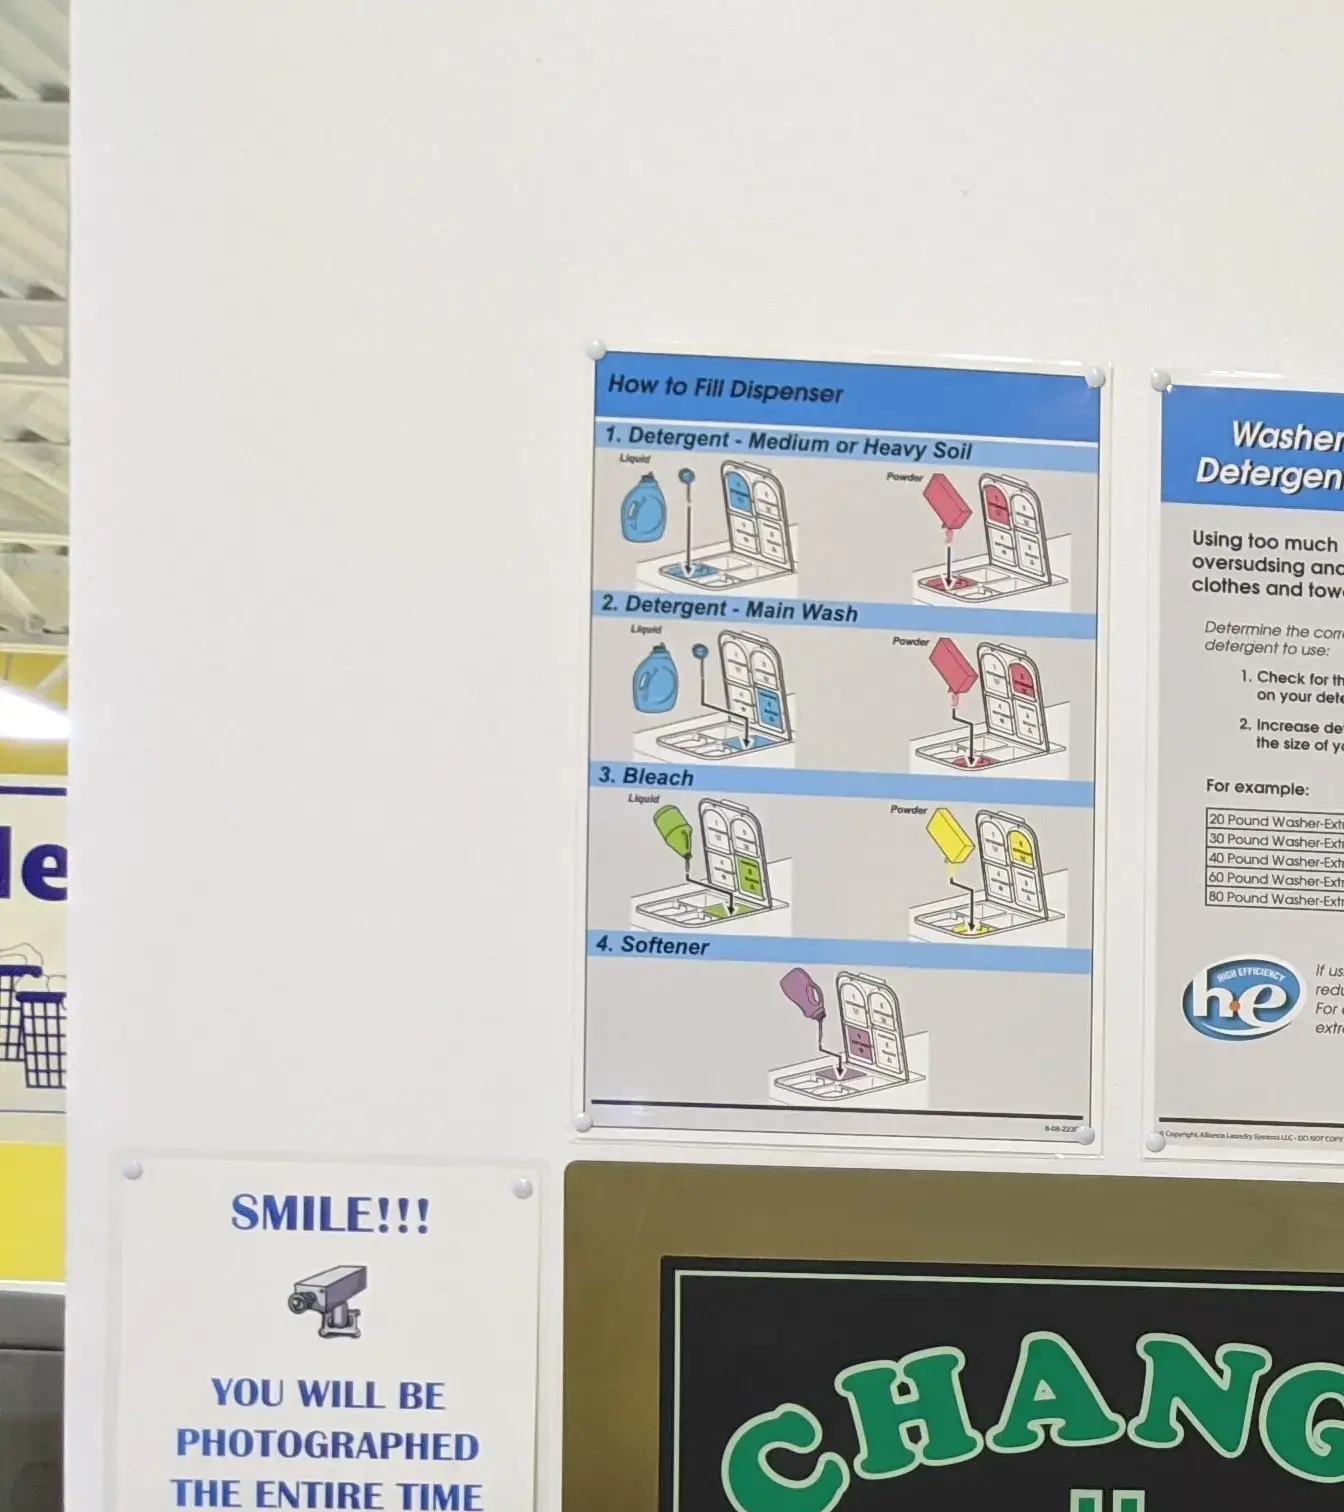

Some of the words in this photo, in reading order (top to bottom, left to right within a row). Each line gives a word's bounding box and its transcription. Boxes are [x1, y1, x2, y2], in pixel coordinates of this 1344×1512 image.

[608, 373, 659, 394] How
[665, 377, 688, 396] to
[695, 378, 725, 397] Fill
[730, 379, 844, 404] Dispenser
[598, 766, 615, 783] 3.
[623, 767, 693, 786] Bleach
[628, 793, 660, 805] Liquid
[1209, 891, 1224, 902] 80
[1227, 892, 1268, 904] Pound
[232, 1194, 429, 1234] SMILE!!!
[211, 1378, 283, 1407] YOU
[297, 1380, 386, 1409] WILL
[400, 1382, 445, 1410] BE
[177, 1429, 479, 1461] PHOTOGRAPHED
[170, 1479, 242, 1507] THE
[256, 1481, 384, 1510] ENTIRE
[396, 1483, 484, 1511] TIME
